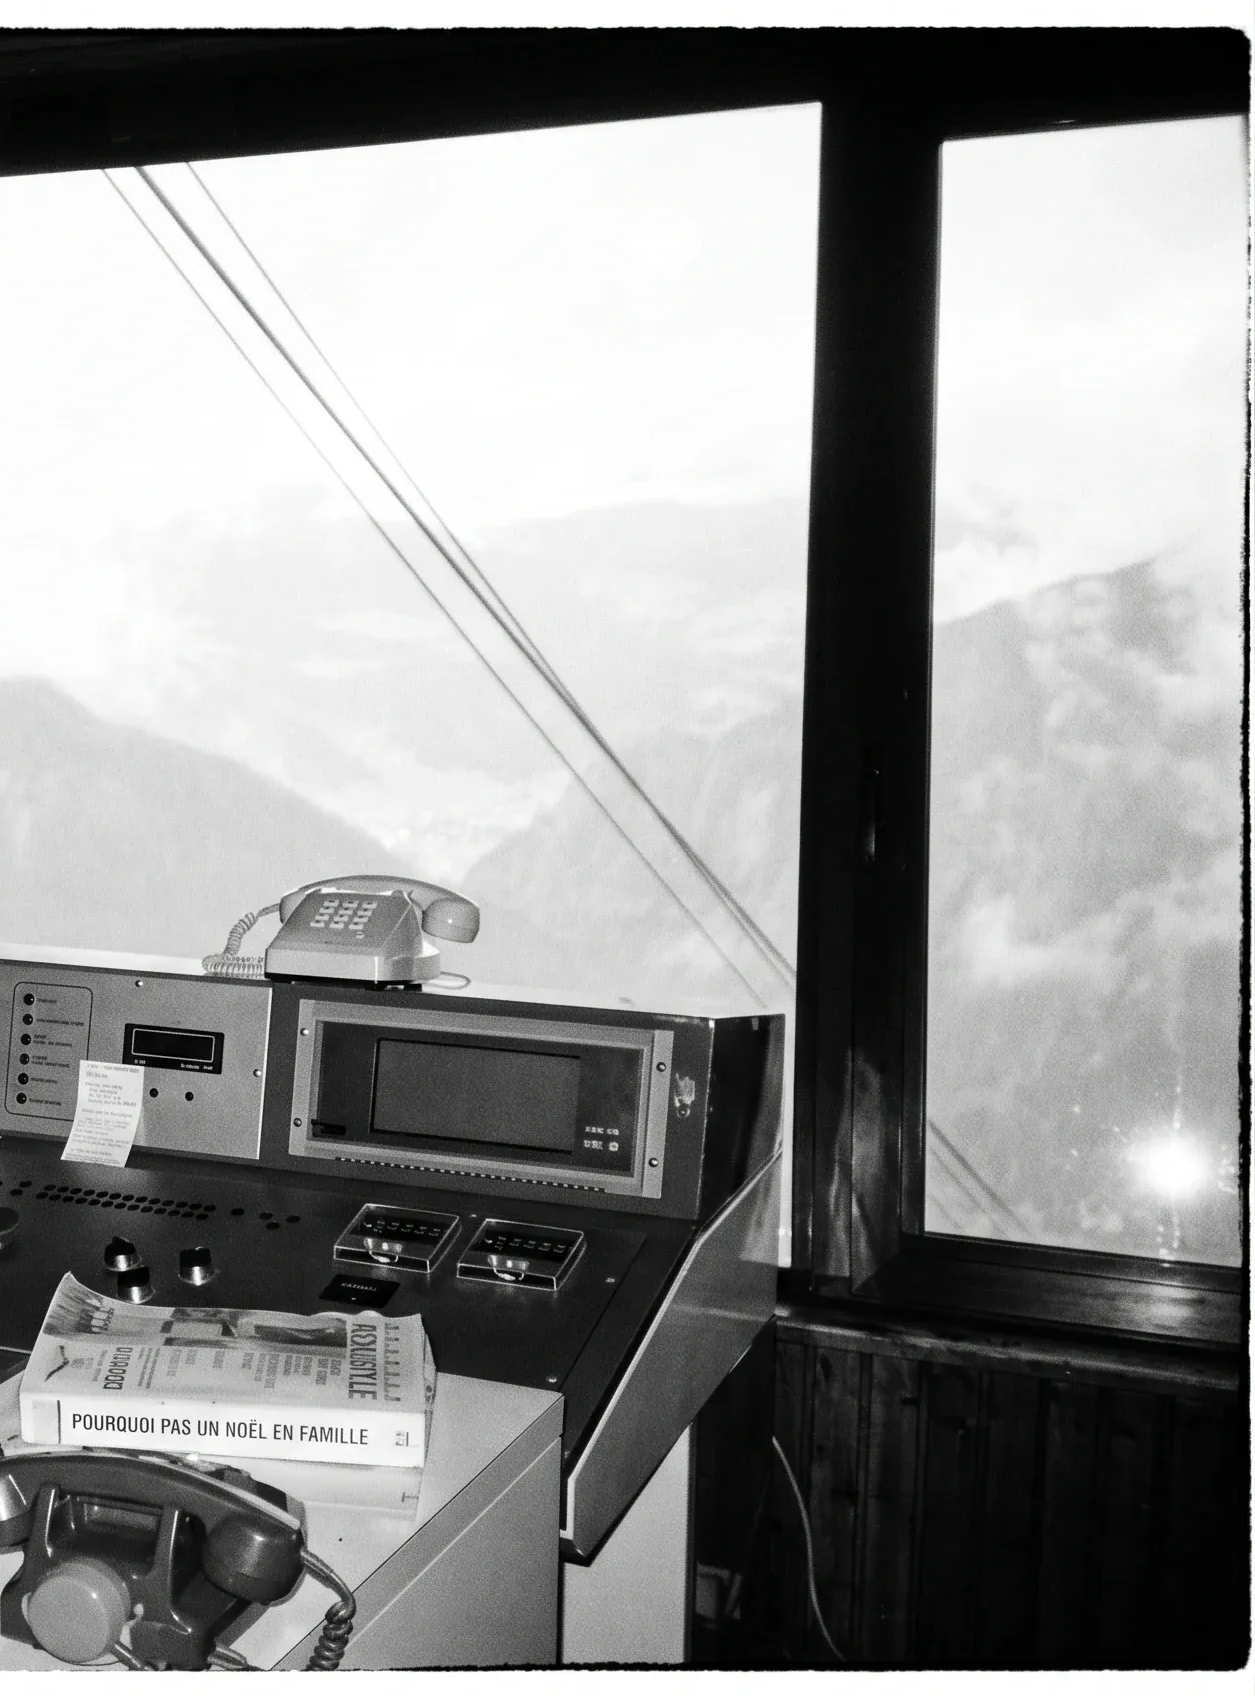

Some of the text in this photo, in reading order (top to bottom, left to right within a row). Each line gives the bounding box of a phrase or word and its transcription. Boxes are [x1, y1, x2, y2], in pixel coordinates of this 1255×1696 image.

[72, 1413, 368, 1445] POURQUOI PAS UN NOËL EN FAMILLE
